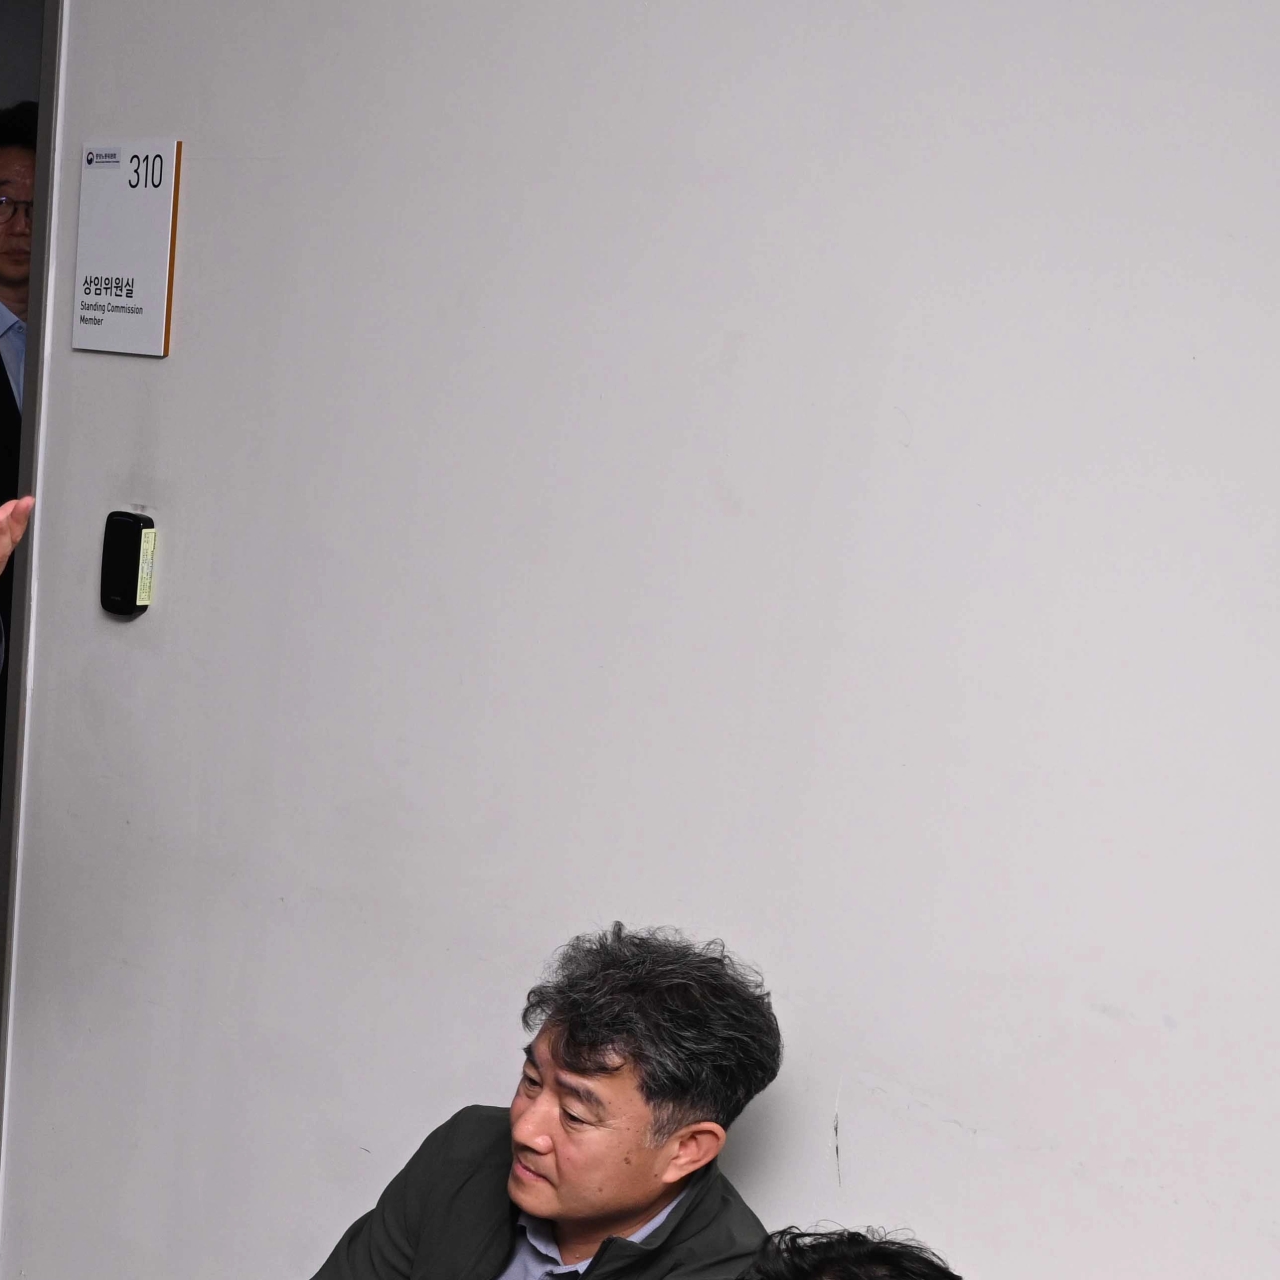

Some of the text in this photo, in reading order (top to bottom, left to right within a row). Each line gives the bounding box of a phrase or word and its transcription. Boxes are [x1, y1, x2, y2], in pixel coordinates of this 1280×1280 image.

[128, 153, 163, 189] 310
[82, 275, 134, 299] 상임위원실
[80, 300, 144, 315] Standing Commission
[80, 314, 104, 326] Member
